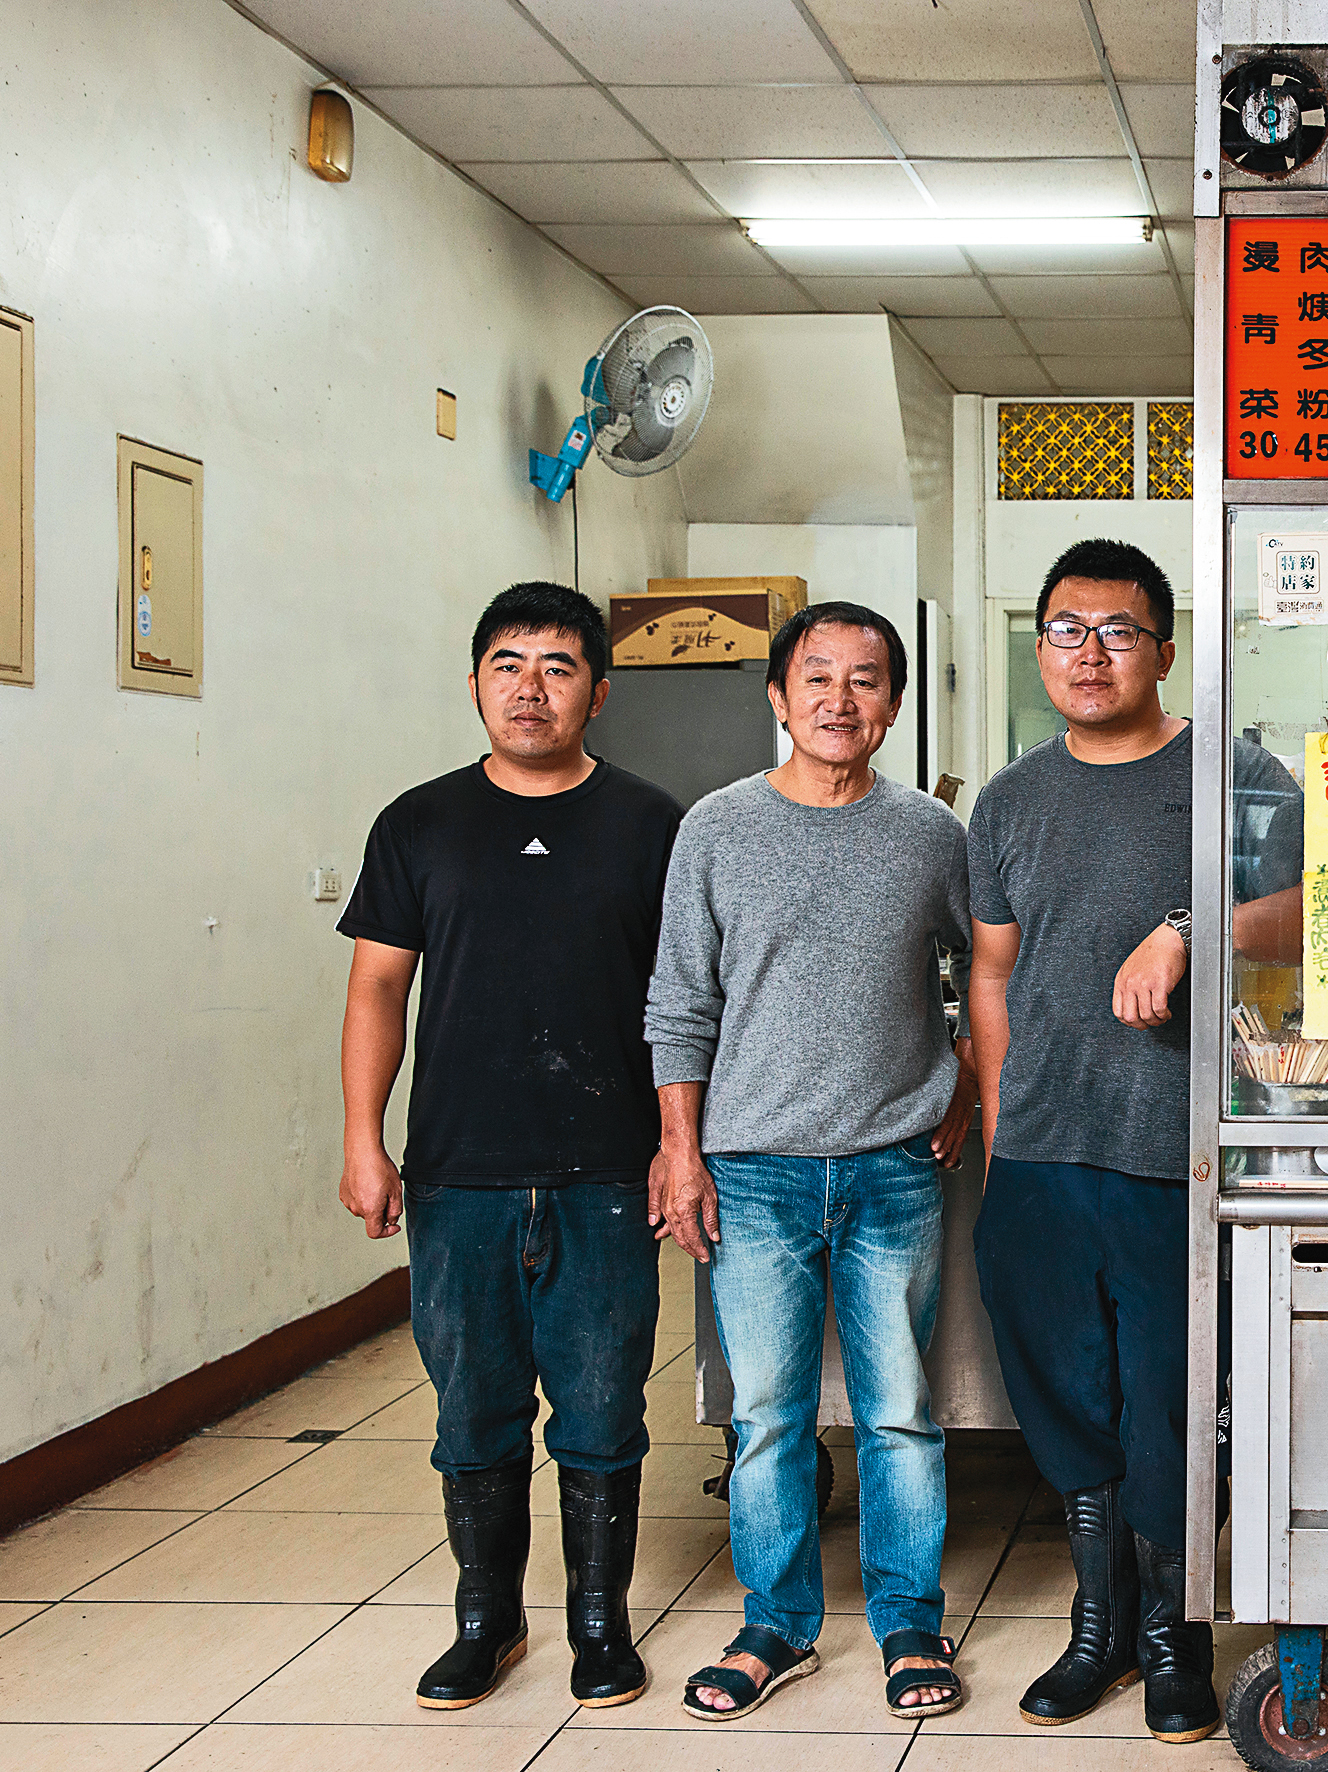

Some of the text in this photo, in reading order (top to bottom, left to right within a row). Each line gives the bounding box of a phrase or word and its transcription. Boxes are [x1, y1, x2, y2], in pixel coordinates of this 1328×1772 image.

[1239, 431, 1279, 459] 30
[1281, 555, 1315, 571] 特約
[1281, 574, 1315, 590] 店家
